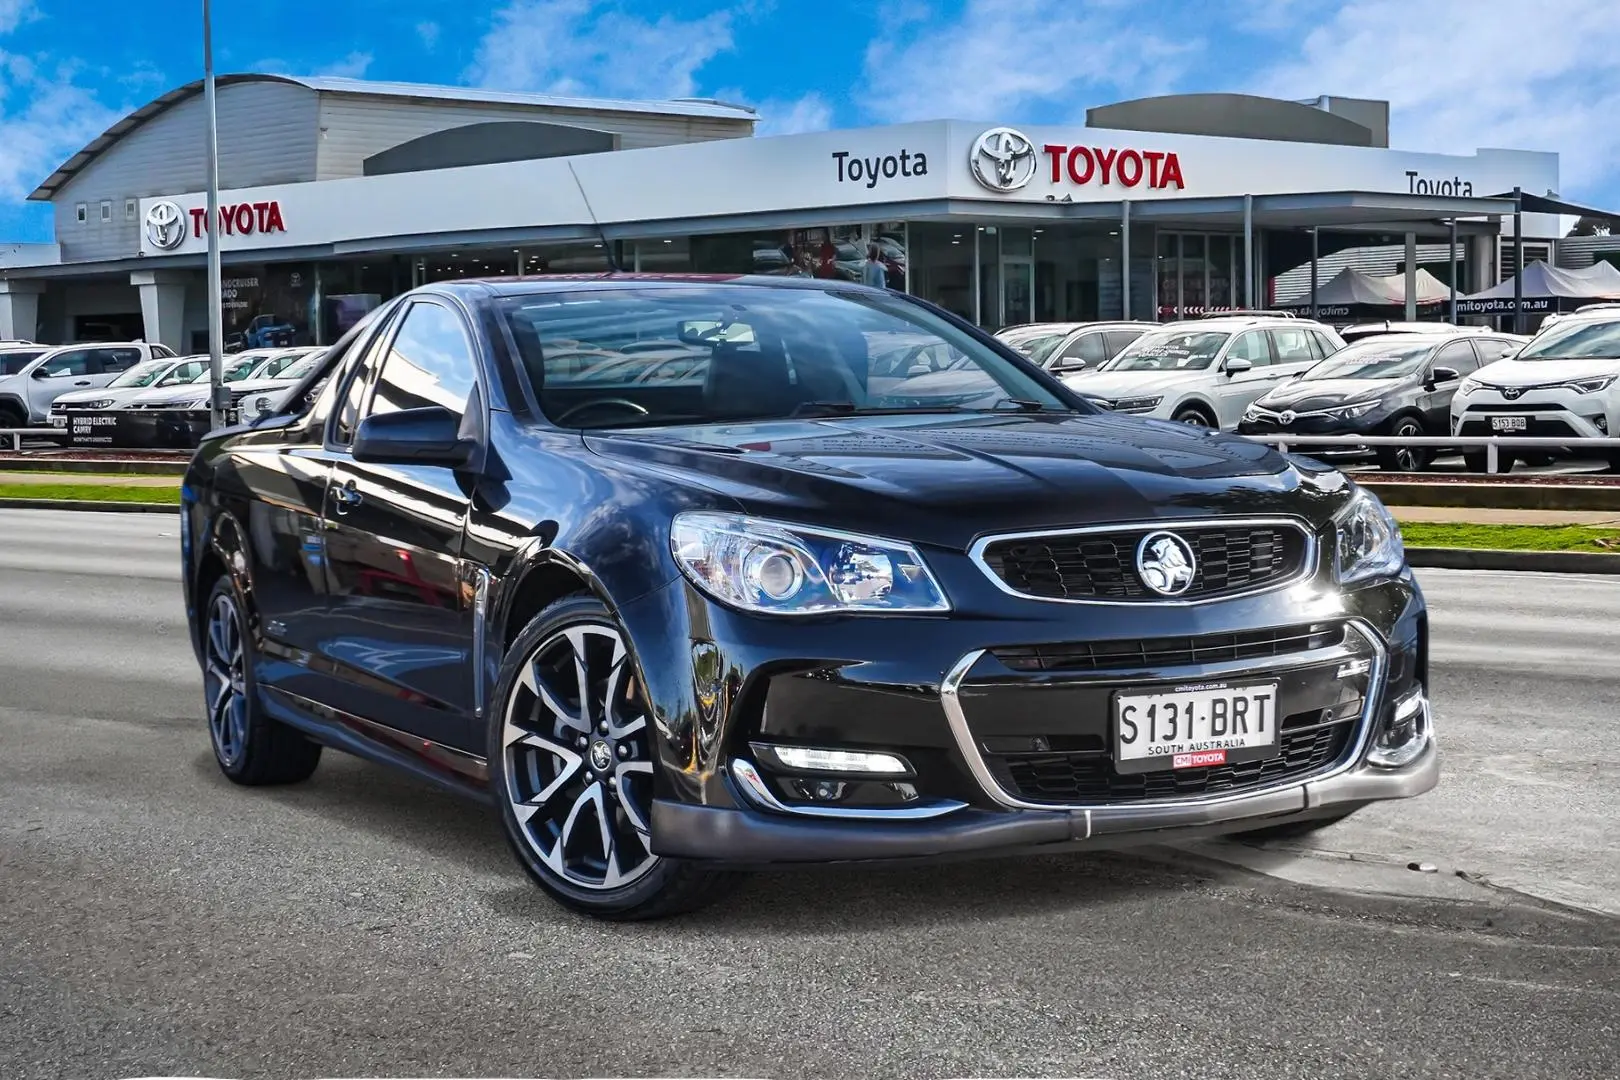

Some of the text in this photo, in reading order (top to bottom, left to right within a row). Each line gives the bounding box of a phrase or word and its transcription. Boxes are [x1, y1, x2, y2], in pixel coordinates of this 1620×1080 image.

[832, 149, 928, 188] Toyota
[1044, 144, 1184, 190] TOYOTA
[1457, 300, 1548, 313] mitoyota.cm.au
[73, 417, 92, 425] HYBRID
[93, 417, 117, 425] ELECTRIC
[73, 426, 92, 434] CAMRY
[1174, 683, 1228, 693] cmitoyota.com.au
[1148, 738, 1246, 755] SOUTH AUSTRALIA
[1192, 753, 1225, 764] TOYOTA
